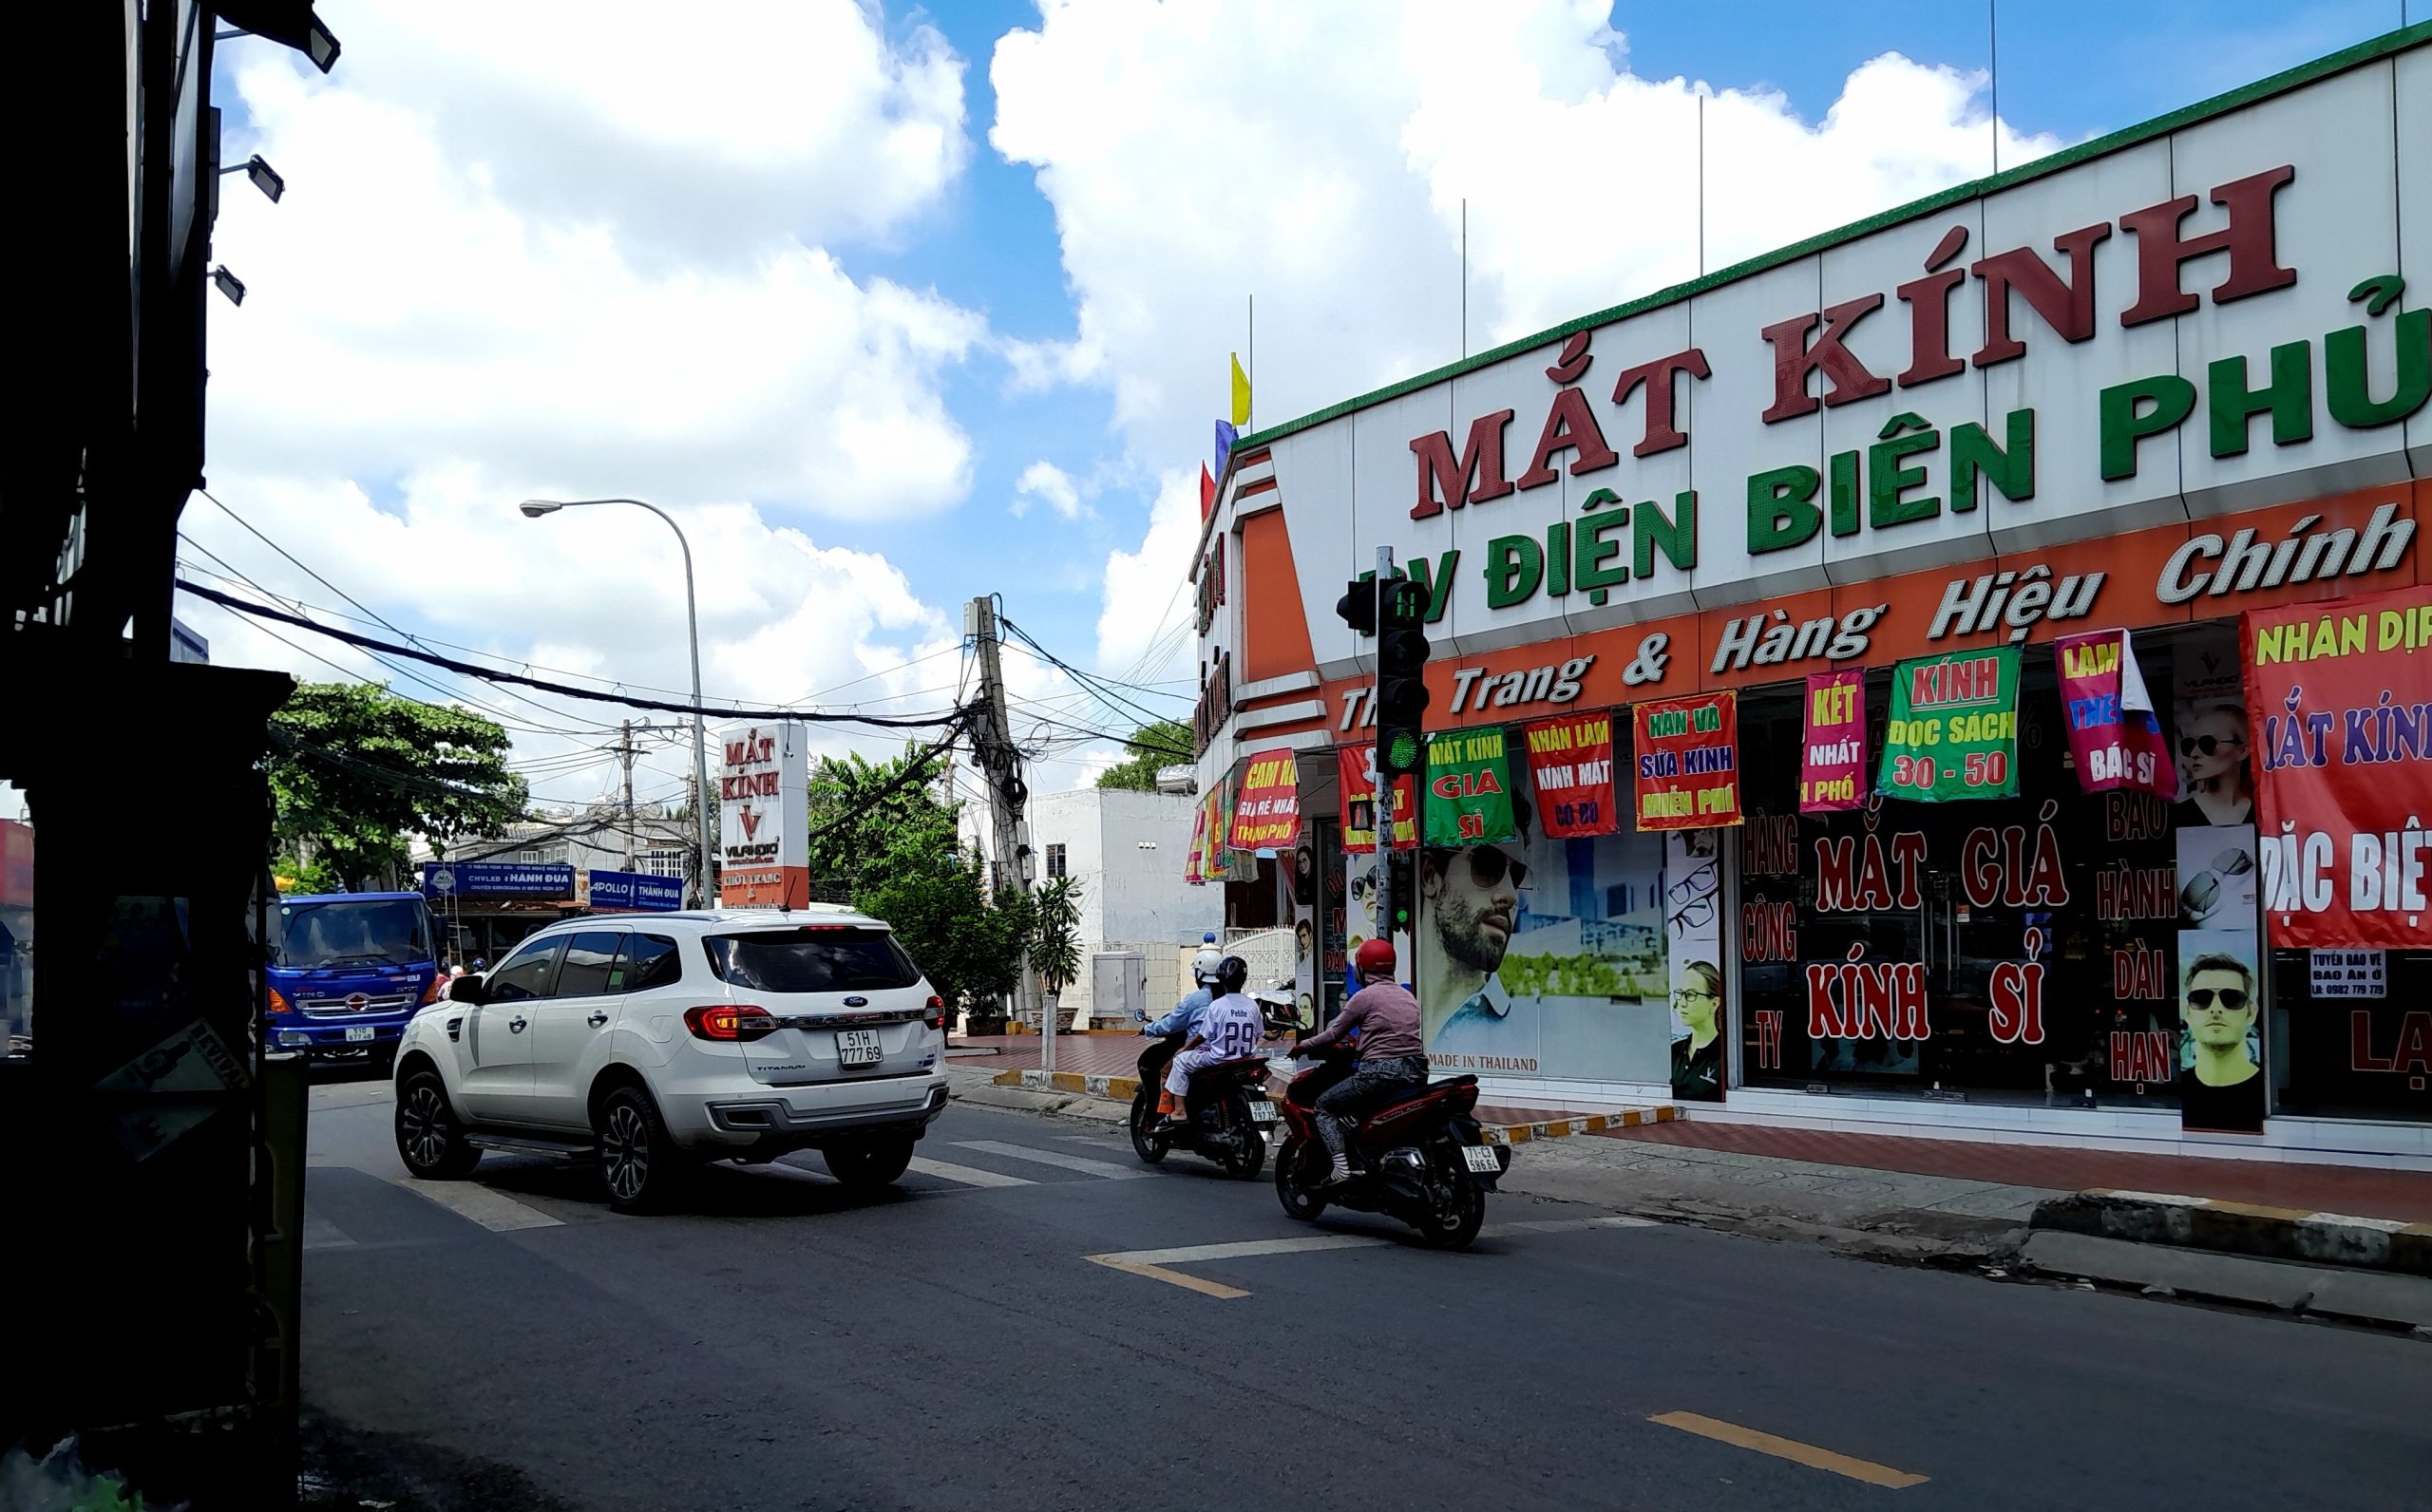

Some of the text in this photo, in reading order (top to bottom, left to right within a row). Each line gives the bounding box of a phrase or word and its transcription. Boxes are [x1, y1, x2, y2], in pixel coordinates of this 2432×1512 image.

[1410, 164, 2297, 520] MẮT KÍNH
[1483, 488, 1698, 609] ĐIỆN
[1746, 408, 2036, 556] BIÊN
[2099, 275, 2432, 482] PHỦ
[1450, 654, 1597, 713] Trang
[1623, 633, 1672, 687] &
[1710, 603, 1890, 674] Hàng
[1927, 564, 2108, 644] Hiệu
[2156, 503, 2417, 606] Chính
[2255, 614, 2368, 667] NHÂN
[2063, 642, 2119, 680] LÀM
[1911, 656, 2000, 707] KÍNH
[1813, 673, 1858, 728] KẾT
[1528, 720, 1609, 755] NHẬN LÀM
[1648, 703, 1721, 739] HÀN VÀ
[1889, 719, 1941, 751] ĐỌC
[1948, 709, 2015, 744] SÁCH
[725, 728, 774, 766] MẮT
[1429, 734, 1503, 766] MẮT KÍNH
[1640, 744, 1734, 780] SỬA KÍNH
[1810, 735, 1860, 765] NHẤT
[2090, 741, 2133, 783] BÁC
[721, 767, 779, 800] KÍNH
[1432, 768, 1504, 799] GIÁ
[1536, 760, 1610, 791] KÍNH MÁT
[1814, 771, 1854, 802] PHỐ
[1892, 754, 1937, 789] 30
[1965, 751, 2008, 787] 50
[1642, 782, 1735, 819] MIỄN PHÍ
[1458, 808, 1484, 840] SỈ
[1743, 808, 1798, 875] HÀNG
[1815, 790, 2069, 912] MẮT GIÁ
[590, 881, 628, 894] APOLLO
[638, 885, 679, 898] THÀNH ĐUA
[2097, 859, 2177, 920] HÀNH
[1741, 893, 1796, 962] CÔNG
[1806, 927, 2045, 1045] KÍNH SỈ
[2114, 937, 2164, 999] DÀI
[2312, 970, 2343, 980] BAO
[2327, 984, 2349, 994] 0982
[2352, 984, 2366, 994] 779
[1230, 1009, 1247, 1018] Petite
[842, 1046, 882, 1063] 777.69
[846, 1031, 870, 1047] 51H
[1226, 1022, 1254, 1057] 29
[1756, 1011, 1783, 1069] TY
[1428, 1053, 1538, 1071] MADE IN THAILAND
[2110, 1031, 2172, 1094] HẠN
